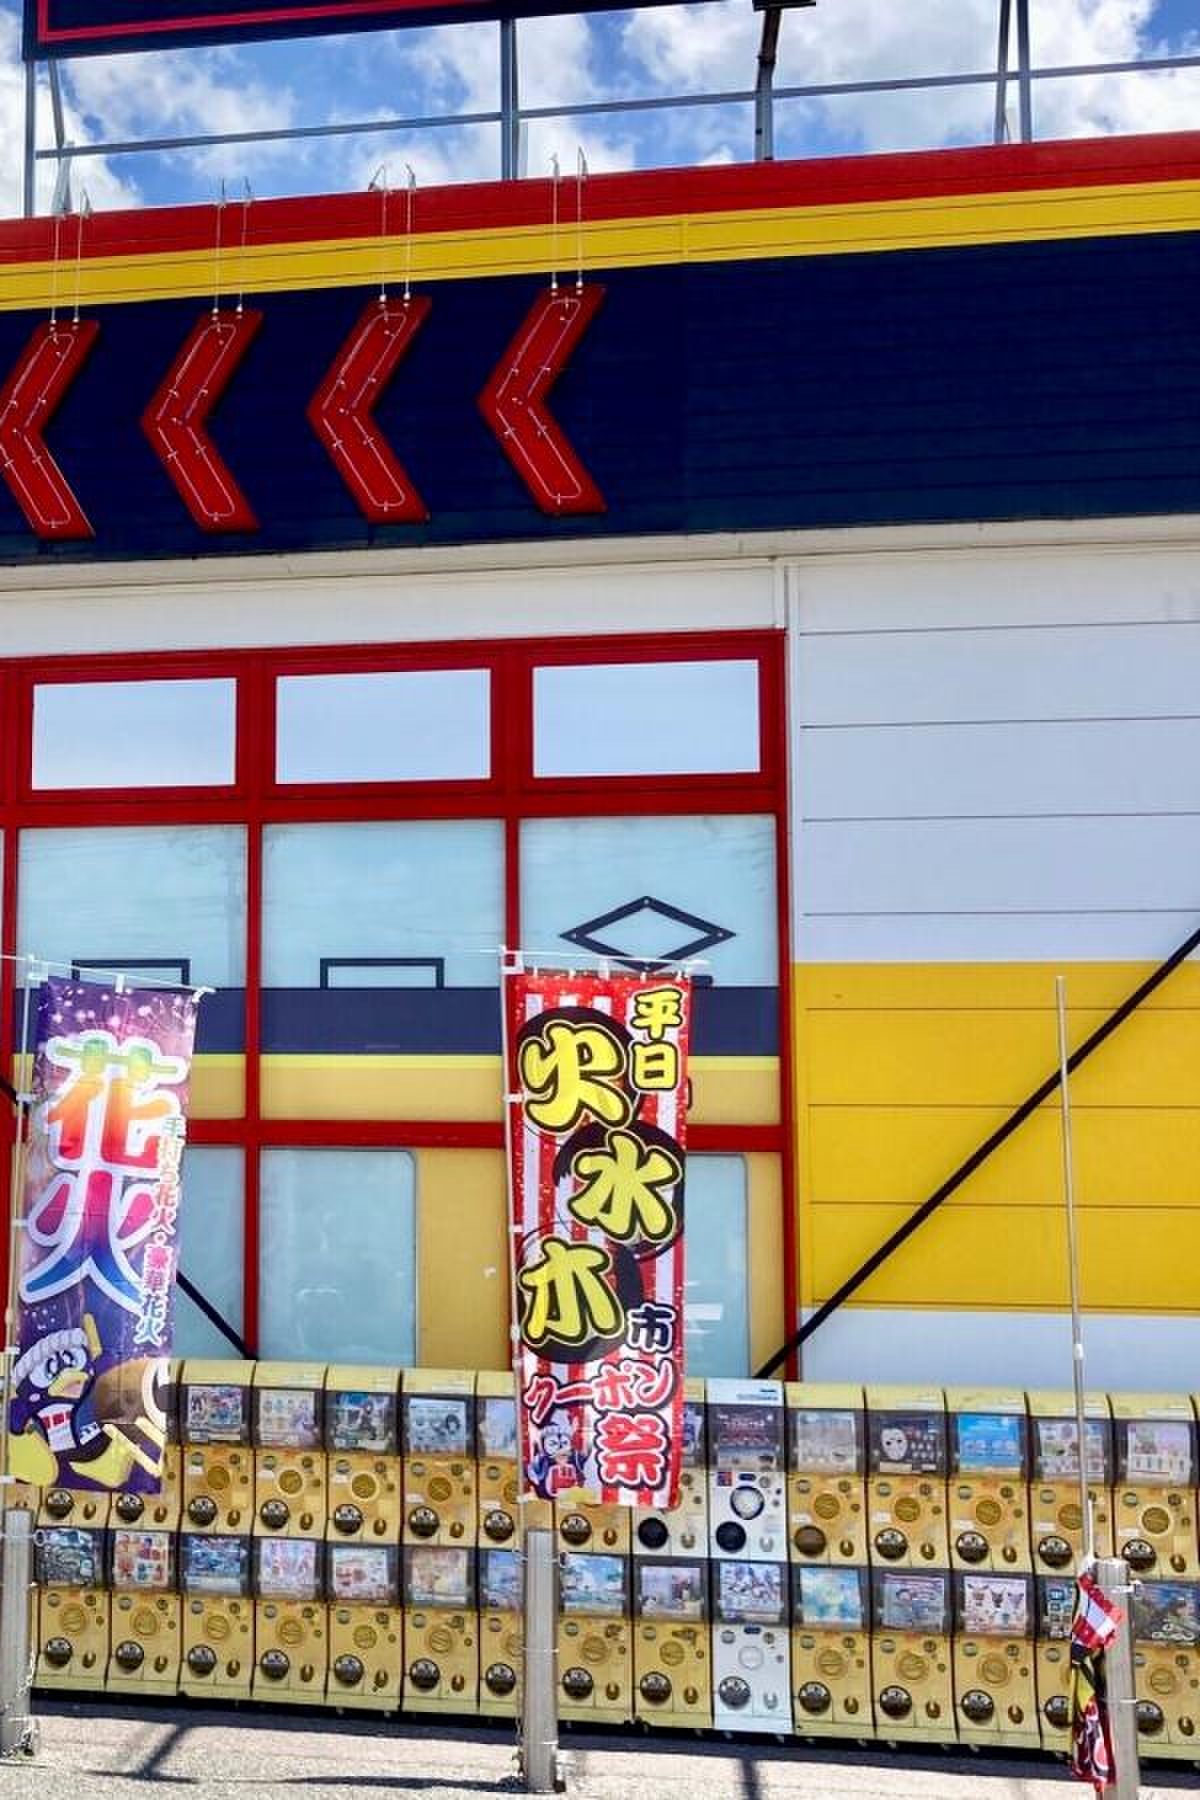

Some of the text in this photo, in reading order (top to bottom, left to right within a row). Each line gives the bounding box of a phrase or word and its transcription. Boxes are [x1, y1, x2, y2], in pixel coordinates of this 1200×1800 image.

[631, 988, 682, 1089] 平日
[20, 1031, 187, 1310] 花火
[525, 1357, 676, 1424] クーポン
